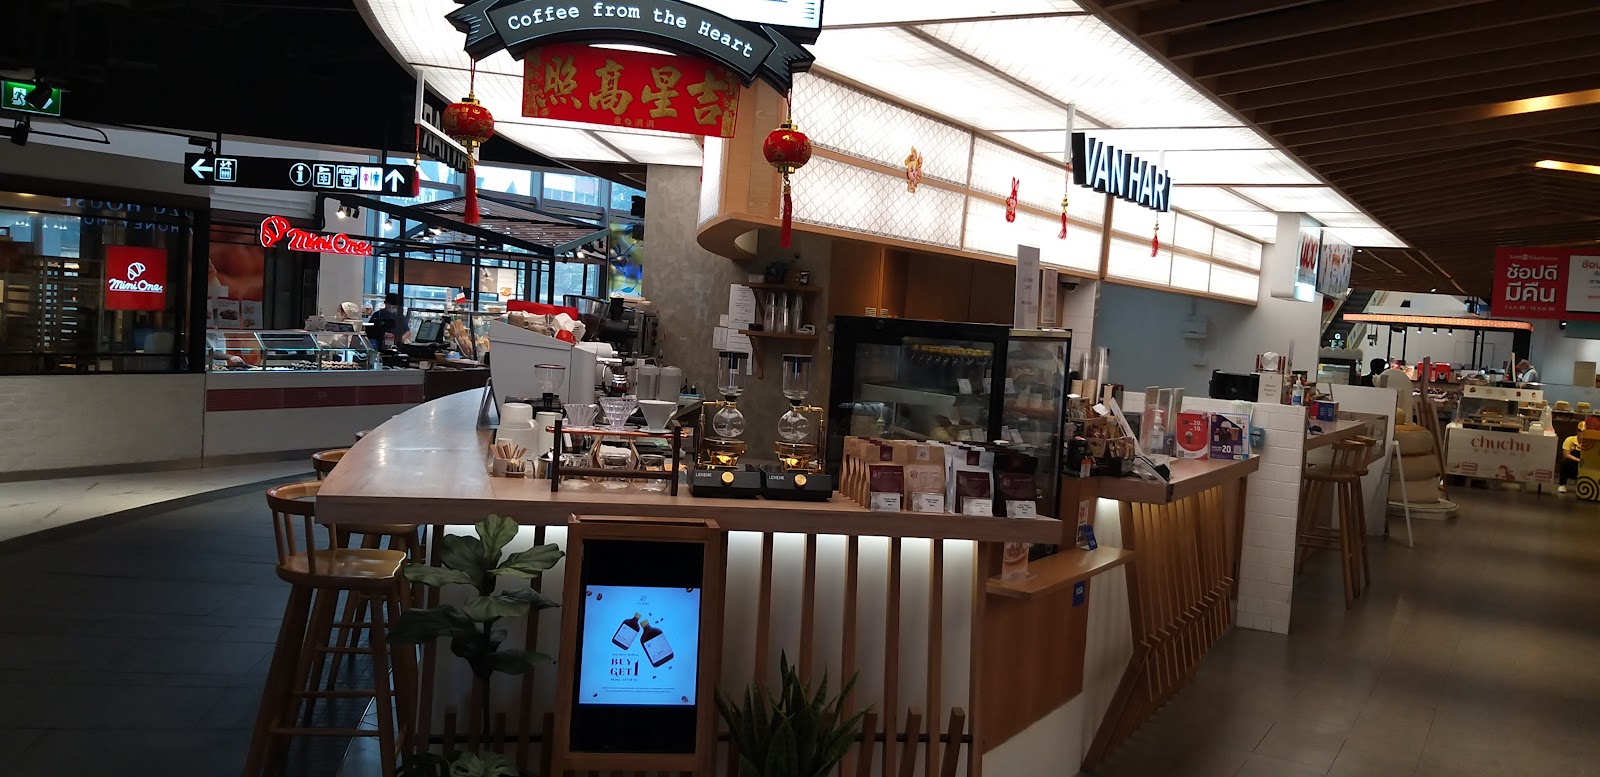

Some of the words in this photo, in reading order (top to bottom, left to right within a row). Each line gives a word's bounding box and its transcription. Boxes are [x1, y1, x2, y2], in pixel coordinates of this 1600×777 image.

[508, 3, 580, 30] Coffee
[593, 2, 641, 19] from
[653, 8, 687, 29] the
[697, 20, 753, 59] Heart
[1084, 131, 1126, 197] VAN
[1506, 263, 1559, 281] ช้อปดี
[1505, 281, 1556, 303] มีคืน
[1222, 445, 1232, 453] 20
[1471, 435, 1531, 452] chuchu
[611, 658, 632, 666] BUY
[610, 667, 633, 677] GET
